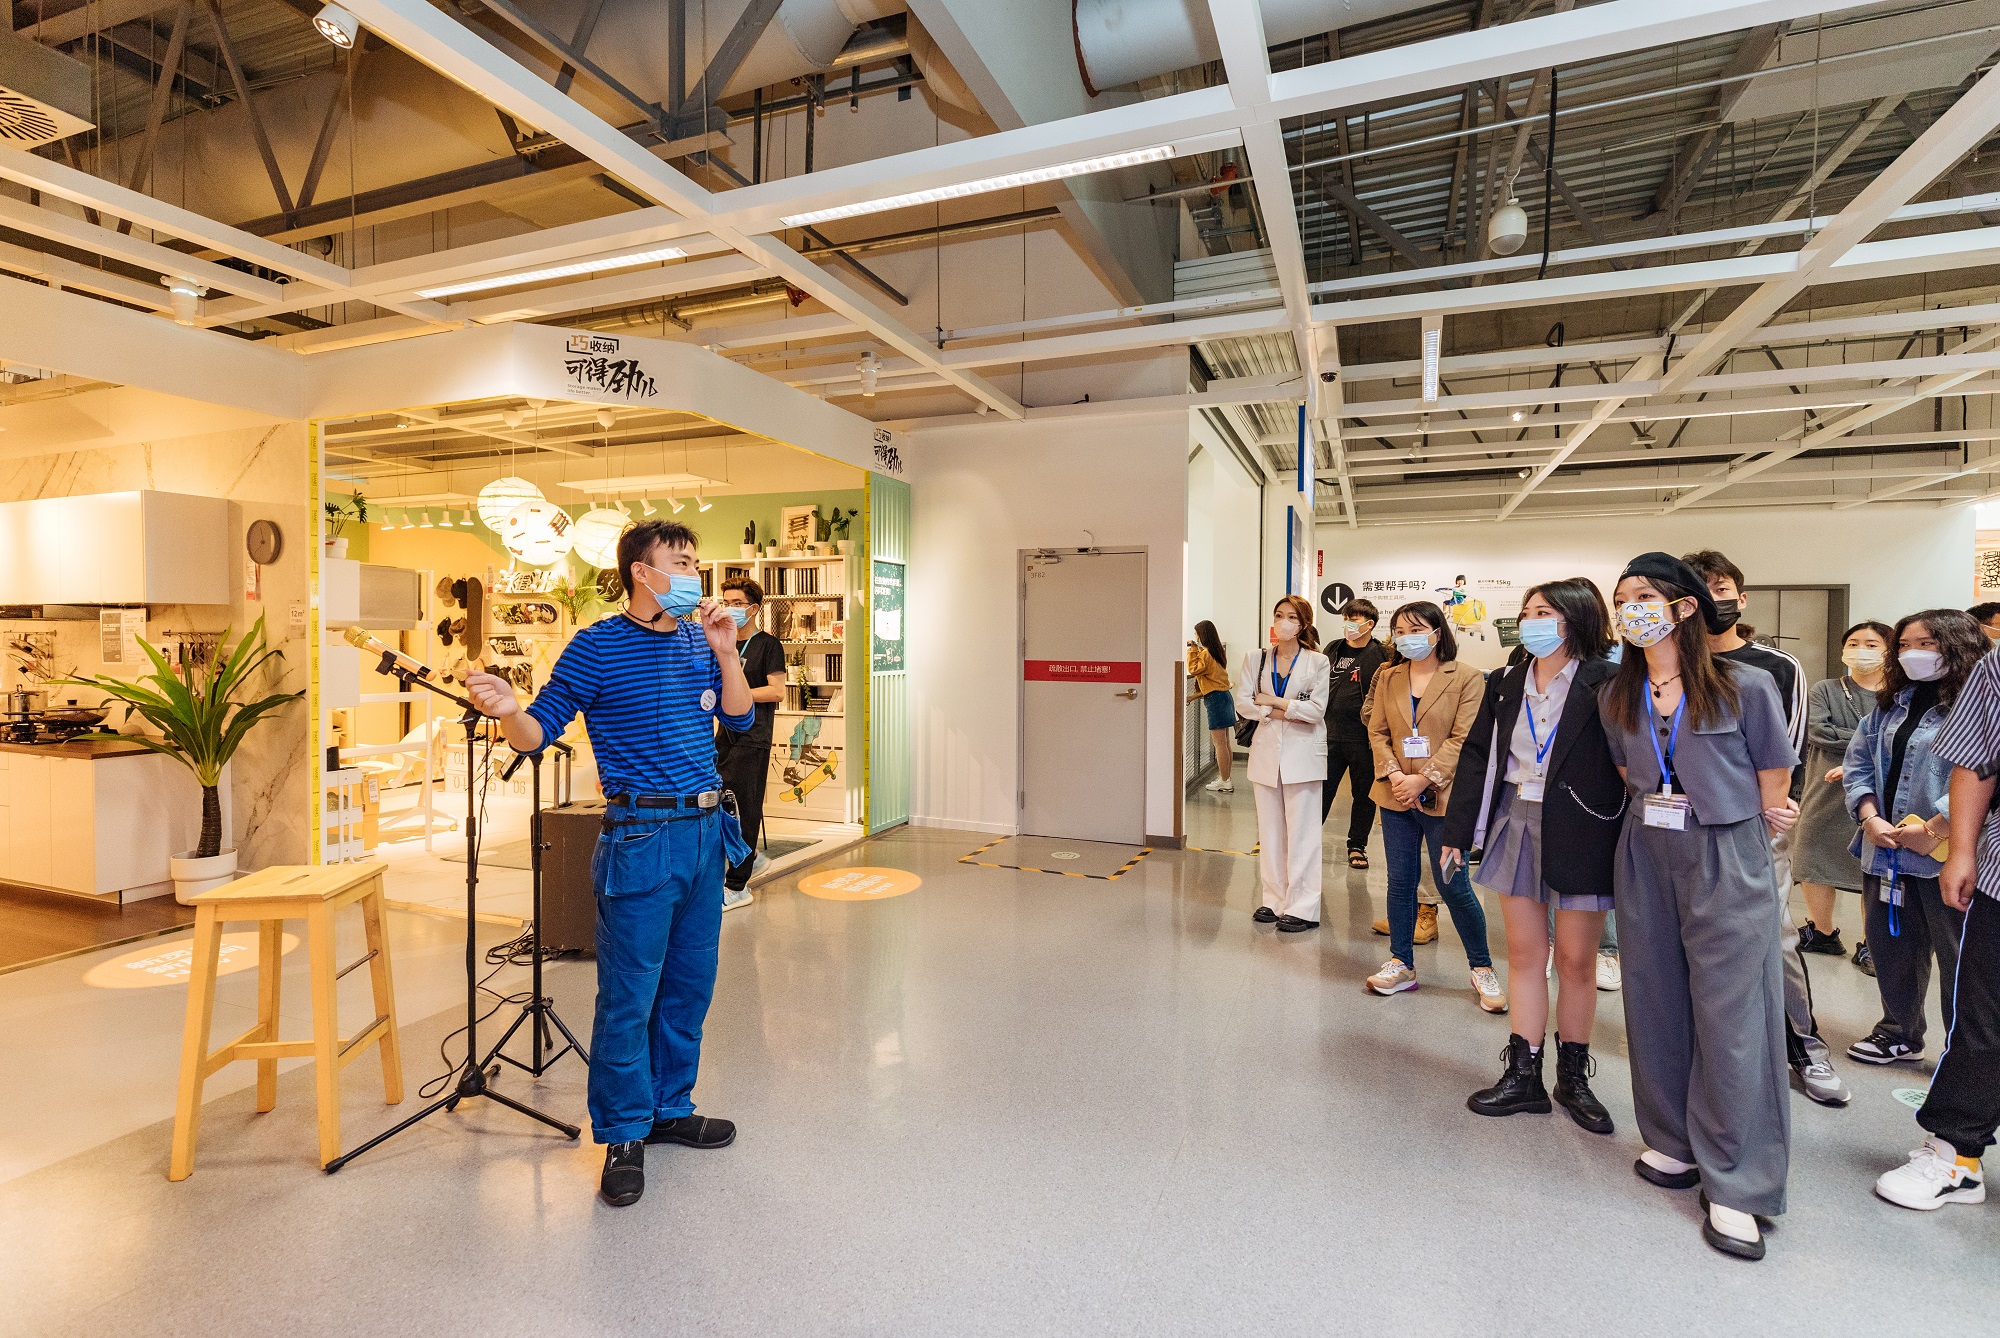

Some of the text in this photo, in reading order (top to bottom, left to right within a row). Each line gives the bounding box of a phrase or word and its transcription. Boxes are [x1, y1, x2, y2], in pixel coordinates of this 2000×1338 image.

[571, 334, 615, 354] 巧收纳
[564, 357, 658, 400] 可得劲儿
[1362, 580, 1427, 592] 需要帮手吗?
